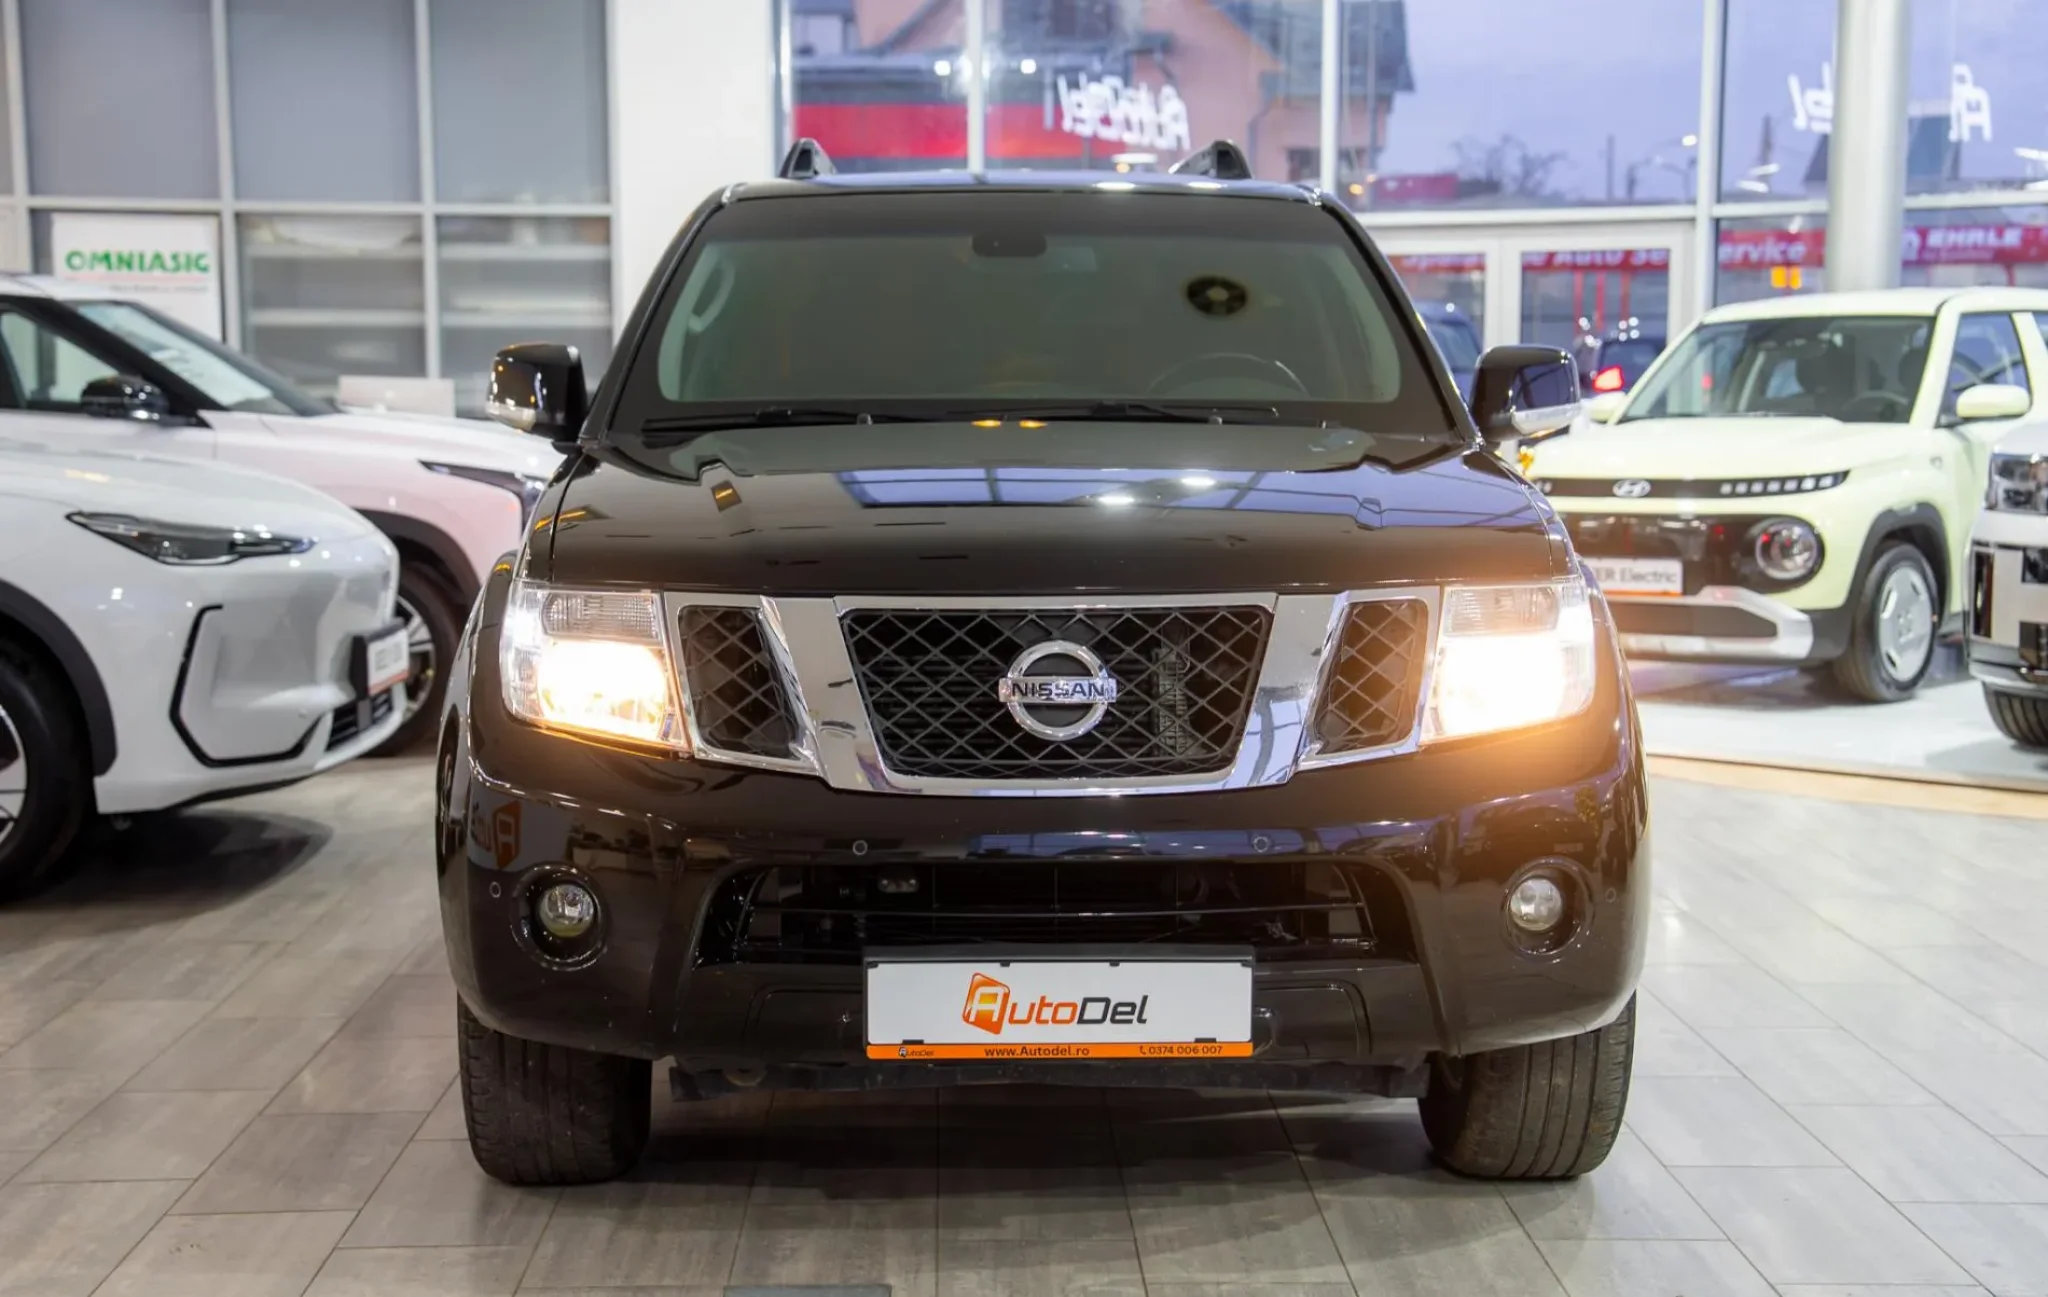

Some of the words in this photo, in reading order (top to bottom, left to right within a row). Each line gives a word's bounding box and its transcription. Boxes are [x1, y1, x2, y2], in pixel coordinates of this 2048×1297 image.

[65, 250, 211, 273] OMNIASIG
[1012, 682, 1105, 697] NISSAN
[965, 982, 1149, 1027] AutoDel
[984, 1045, 1090, 1058] www.Autodel.ro
[1148, 1045, 1174, 1056] 0374
[1177, 1045, 1199, 1056] 006
[1201, 1045, 1223, 1055] 007
